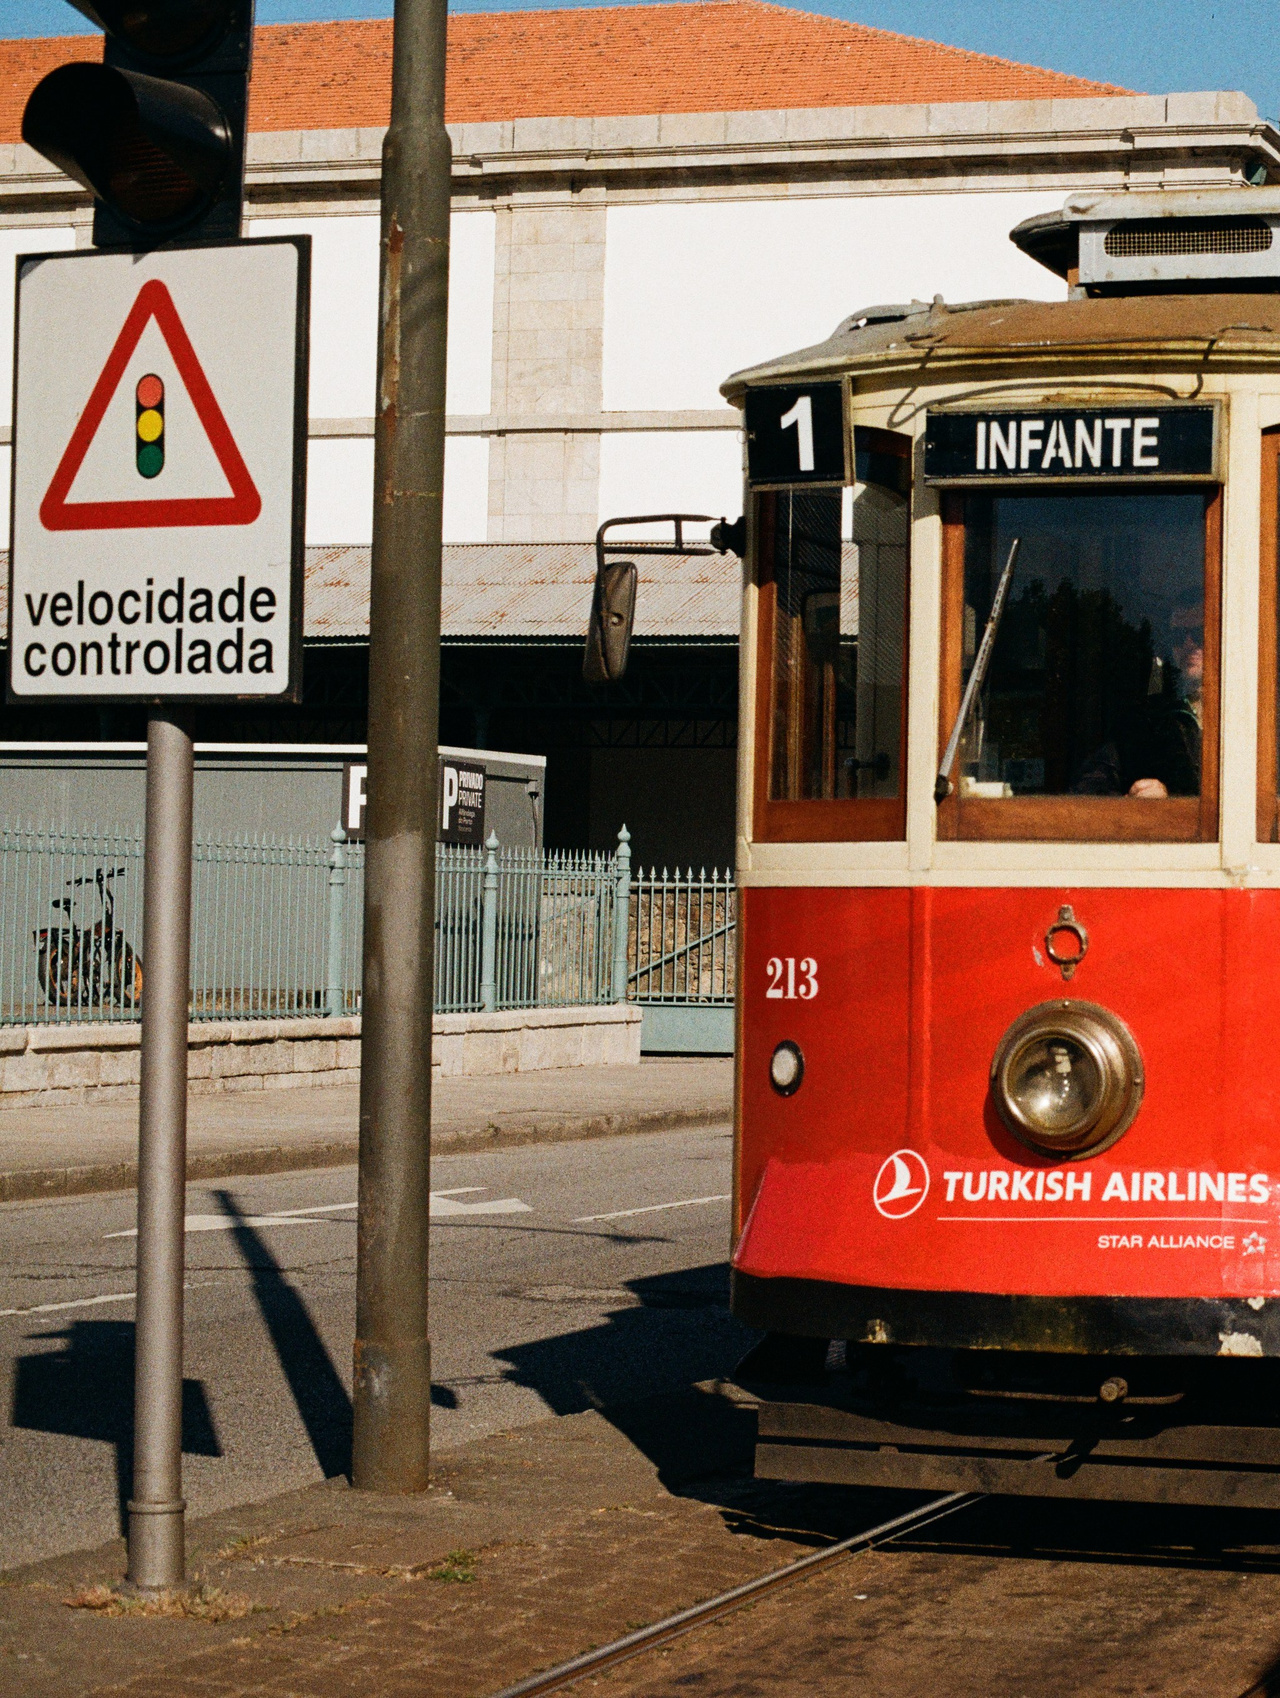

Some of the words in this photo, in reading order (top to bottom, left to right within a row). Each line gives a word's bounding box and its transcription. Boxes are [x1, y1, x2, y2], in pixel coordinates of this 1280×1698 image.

[780, 396, 815, 471] 1
[976, 417, 1160, 470] INFANTE
[24, 576, 277, 627] velocidade
[23, 628, 274, 677] controlada
[442, 766, 459, 830] P
[458, 770, 484, 791] PRIVADO
[458, 790, 483, 808] PRIVATE
[765, 957, 819, 1000] 213
[943, 1170, 1092, 1202] TURKISH
[1102, 1171, 1270, 1203] AIRLINES
[1097, 1235, 1143, 1249] STAR
[1147, 1235, 1235, 1249] ALLIANCE
